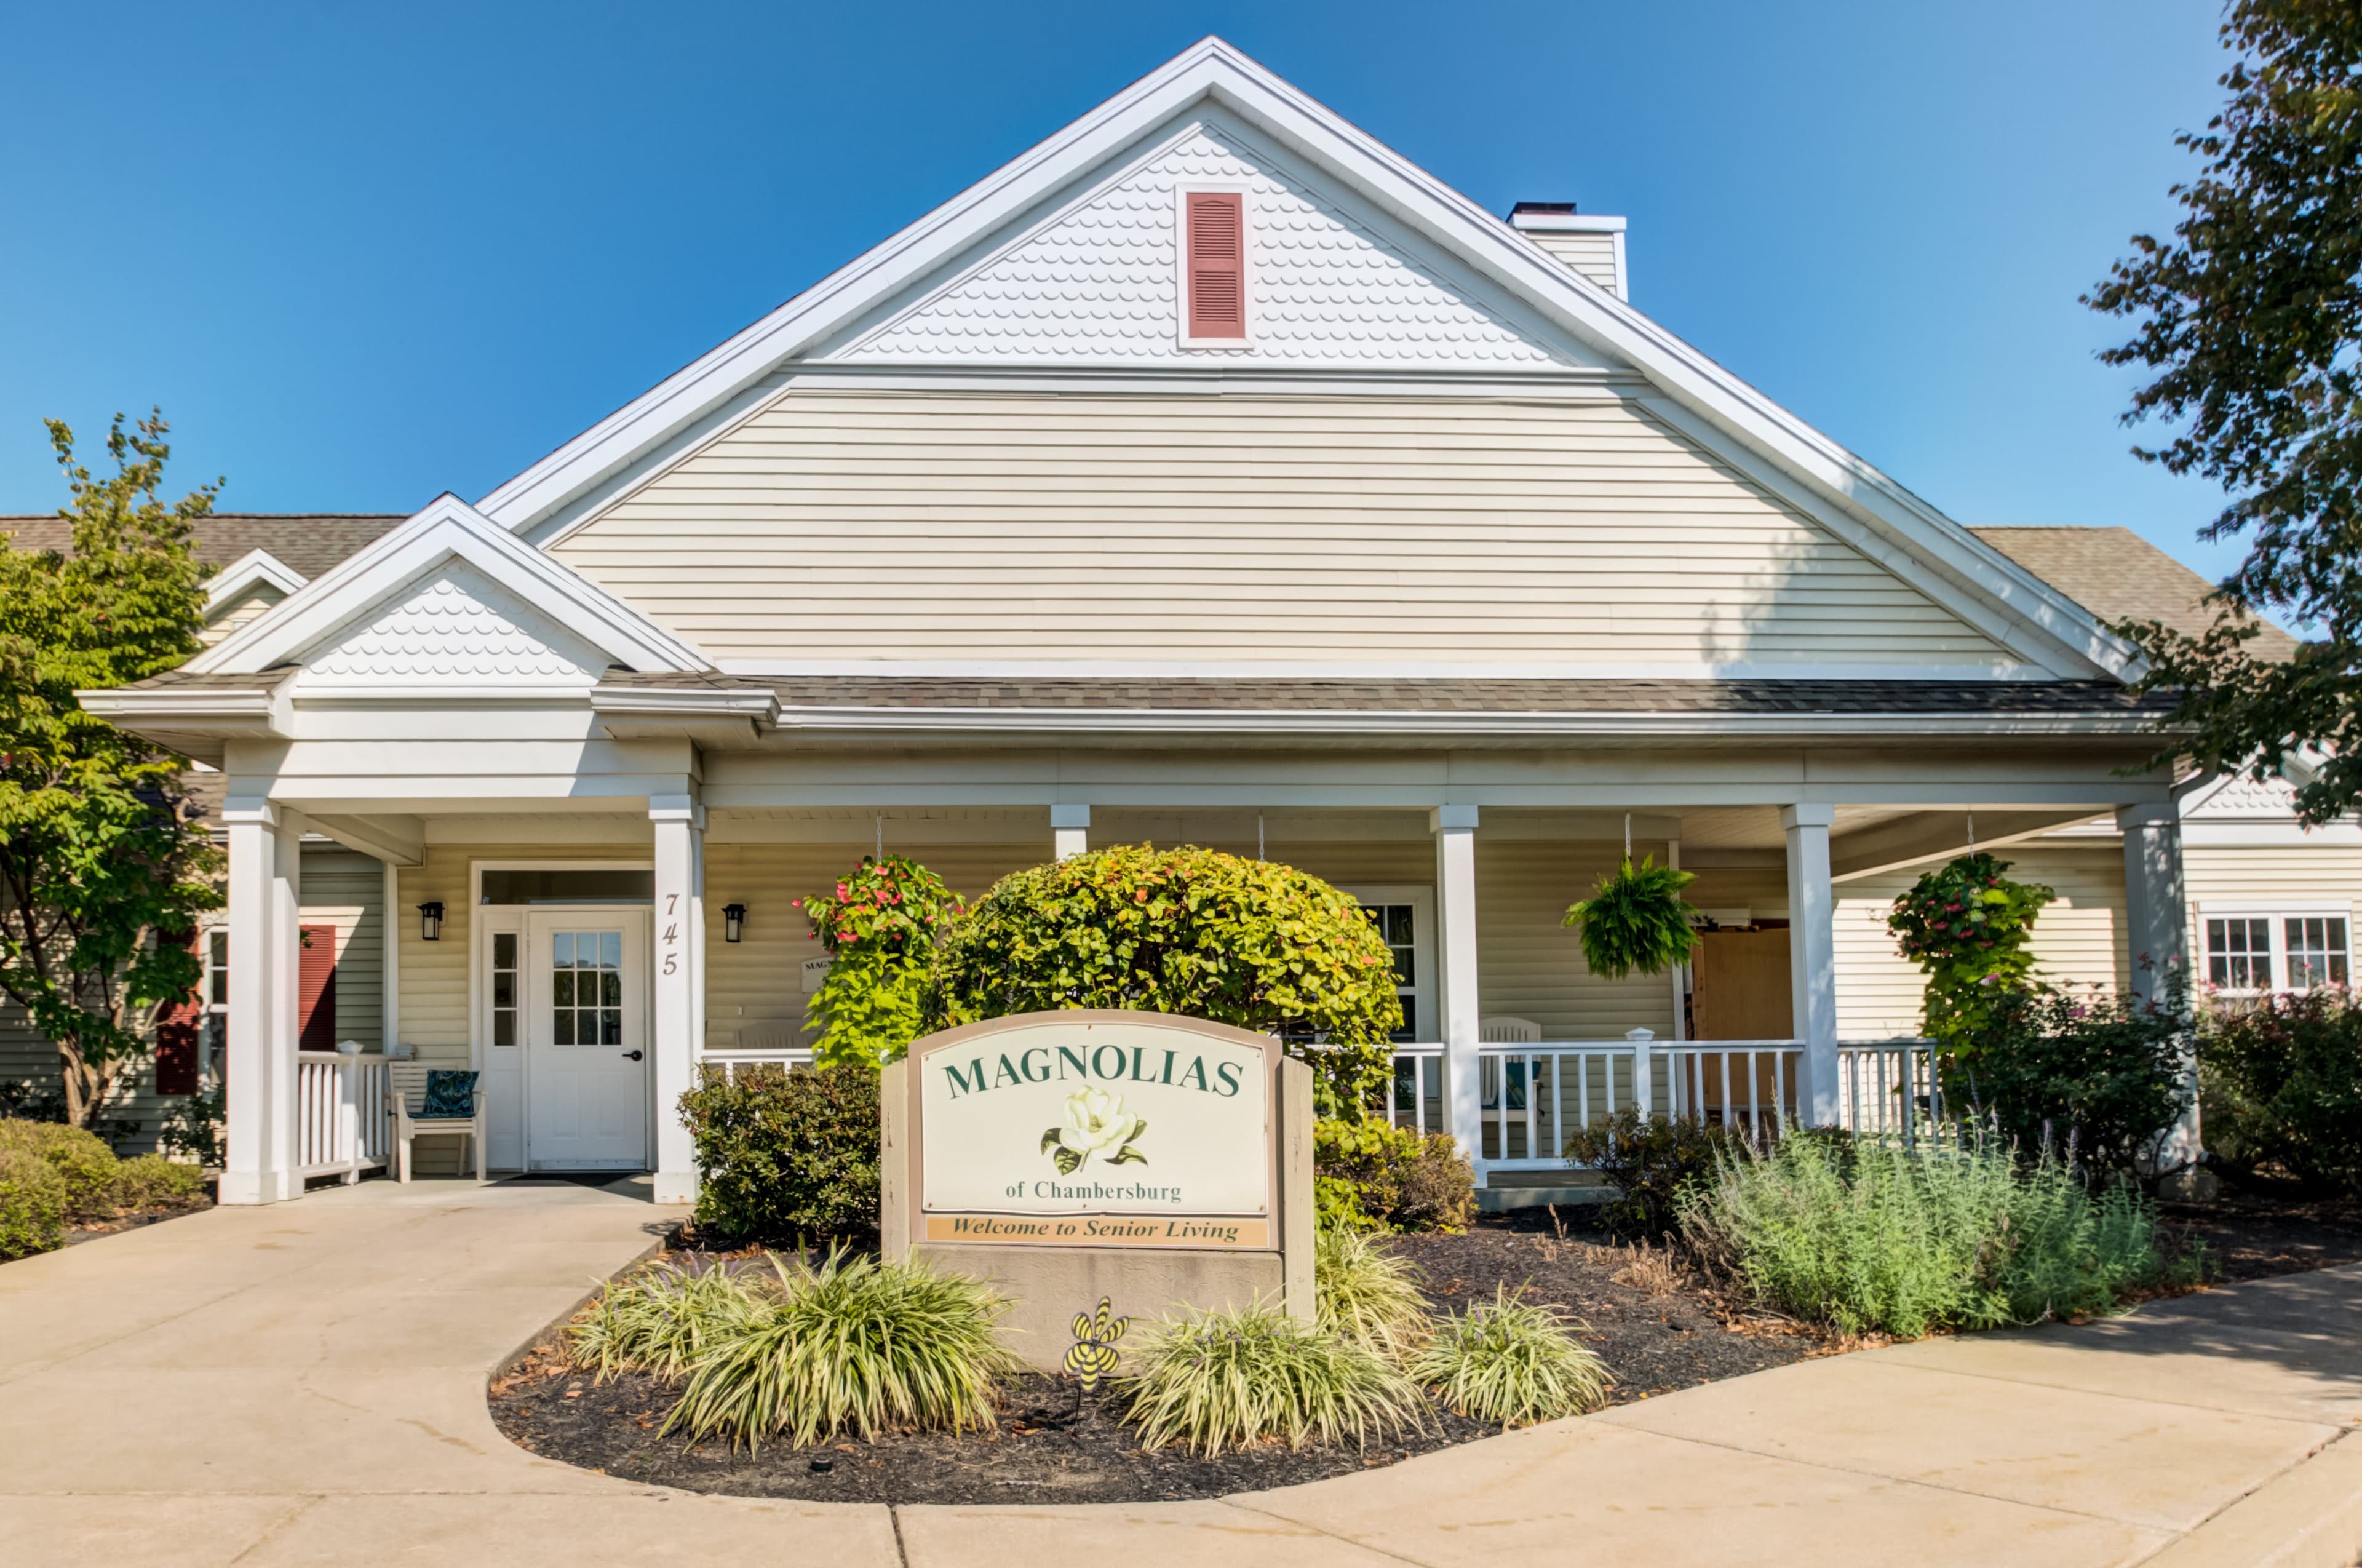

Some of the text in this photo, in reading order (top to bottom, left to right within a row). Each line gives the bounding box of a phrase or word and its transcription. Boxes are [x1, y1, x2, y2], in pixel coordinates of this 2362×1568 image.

[662, 893, 680, 976] 745
[942, 1045, 1244, 1099] MAGNOLIAS
[1006, 1181, 1182, 1203] of Chambersburg
[953, 1218, 1239, 1243] Welcome to Senior Living
